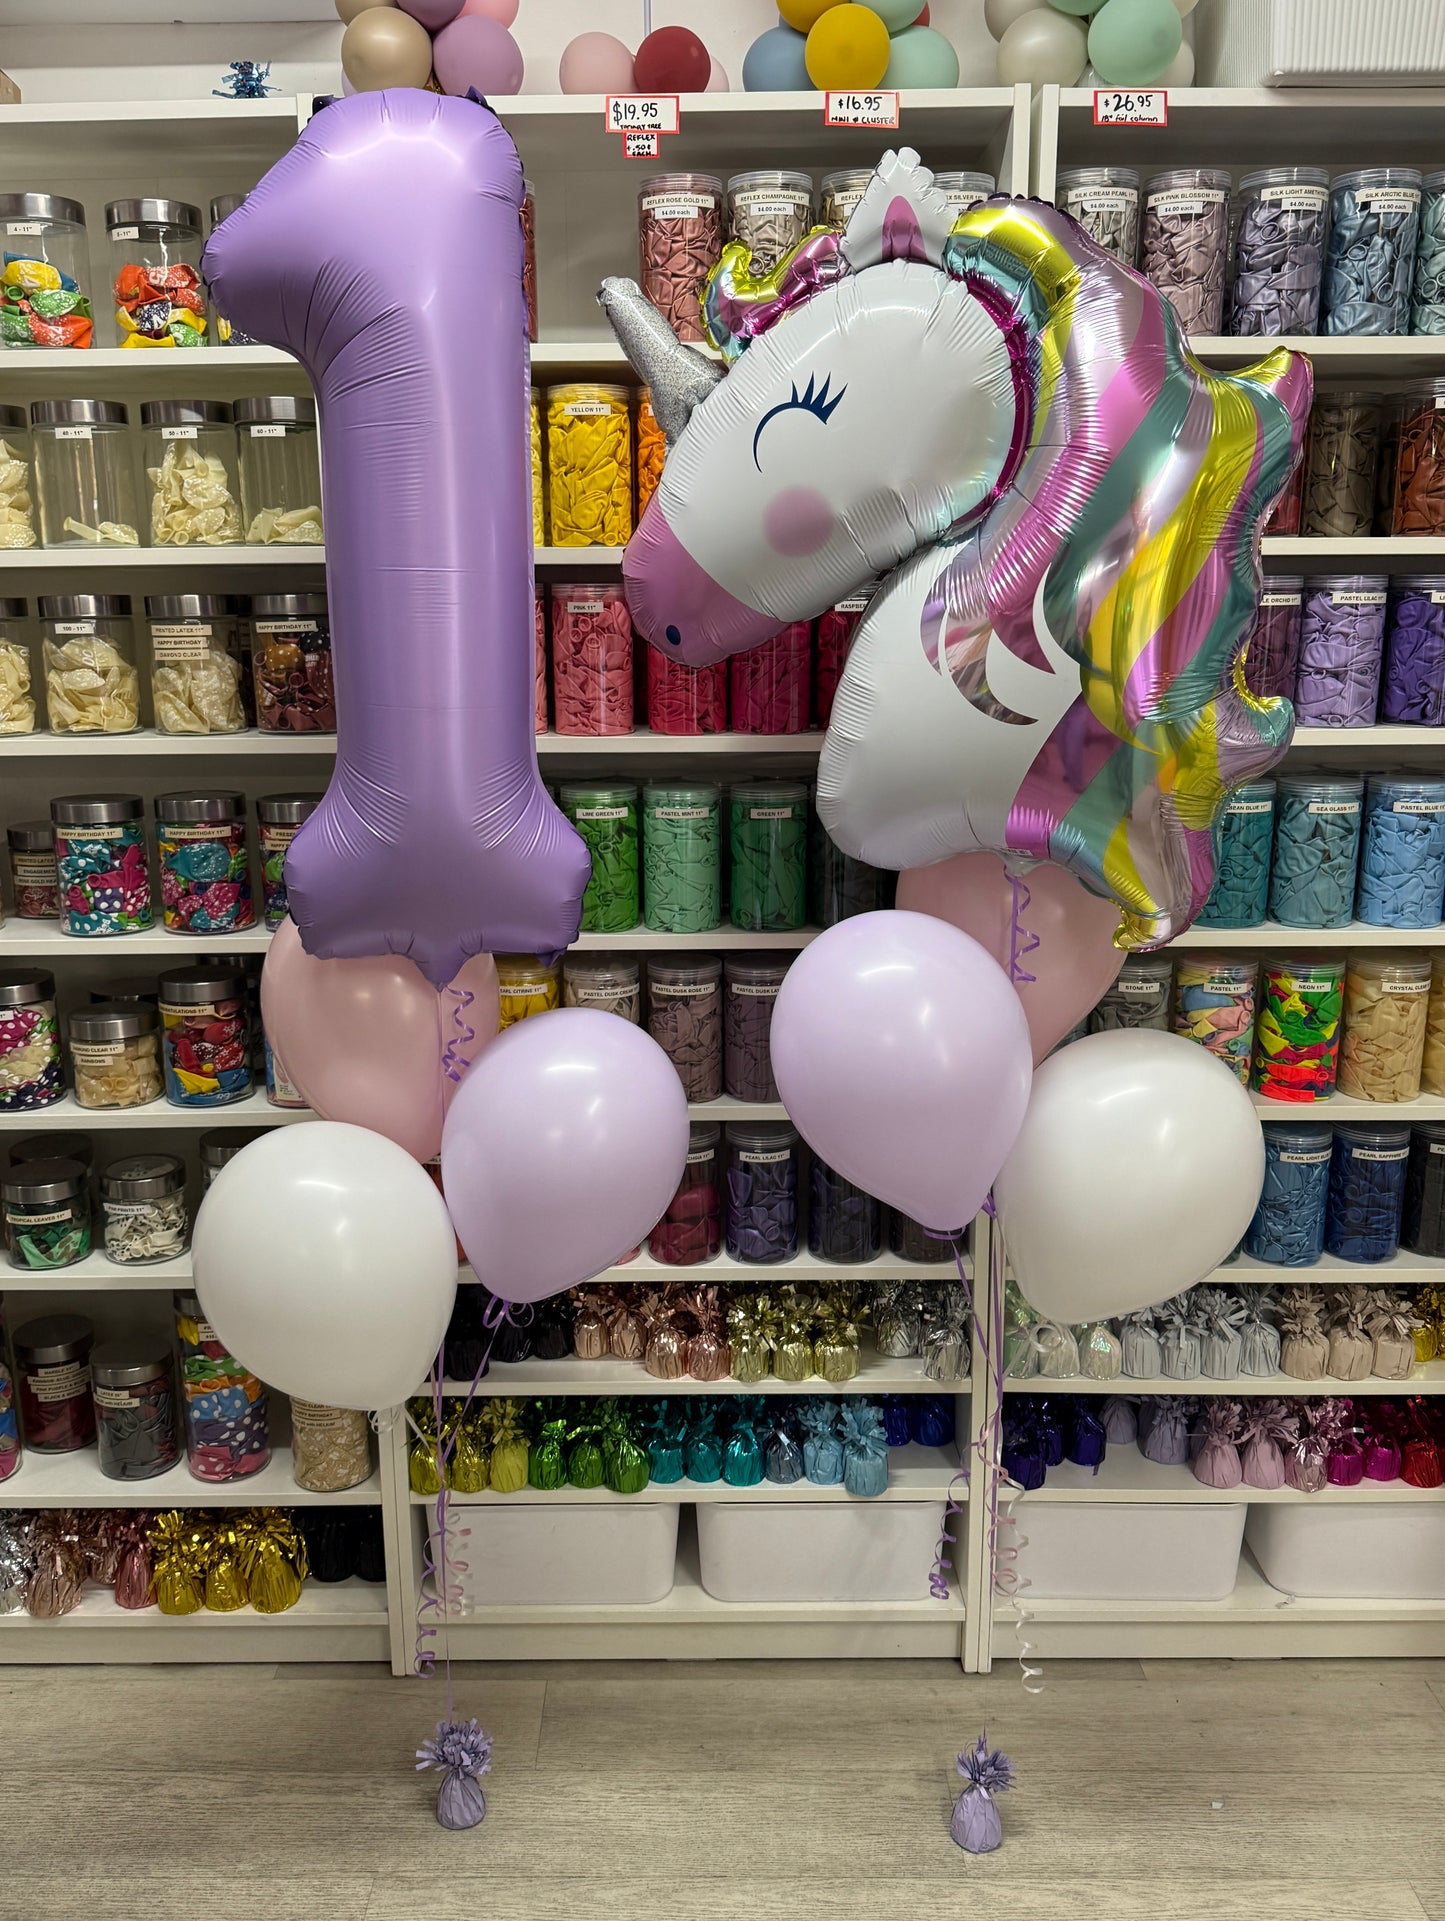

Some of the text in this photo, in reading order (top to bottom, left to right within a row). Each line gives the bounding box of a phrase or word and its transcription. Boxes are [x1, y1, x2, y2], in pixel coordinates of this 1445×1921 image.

[838, 95, 882, 111] $16.95
[1103, 93, 1153, 113] $26.95
[612, 100, 658, 126] $19.95
[1115, 113, 1128, 122] foil
[1130, 114, 1158, 122] column
[861, 116, 895, 125] CLUSTER
[626, 133, 656, 141] REFLEX
